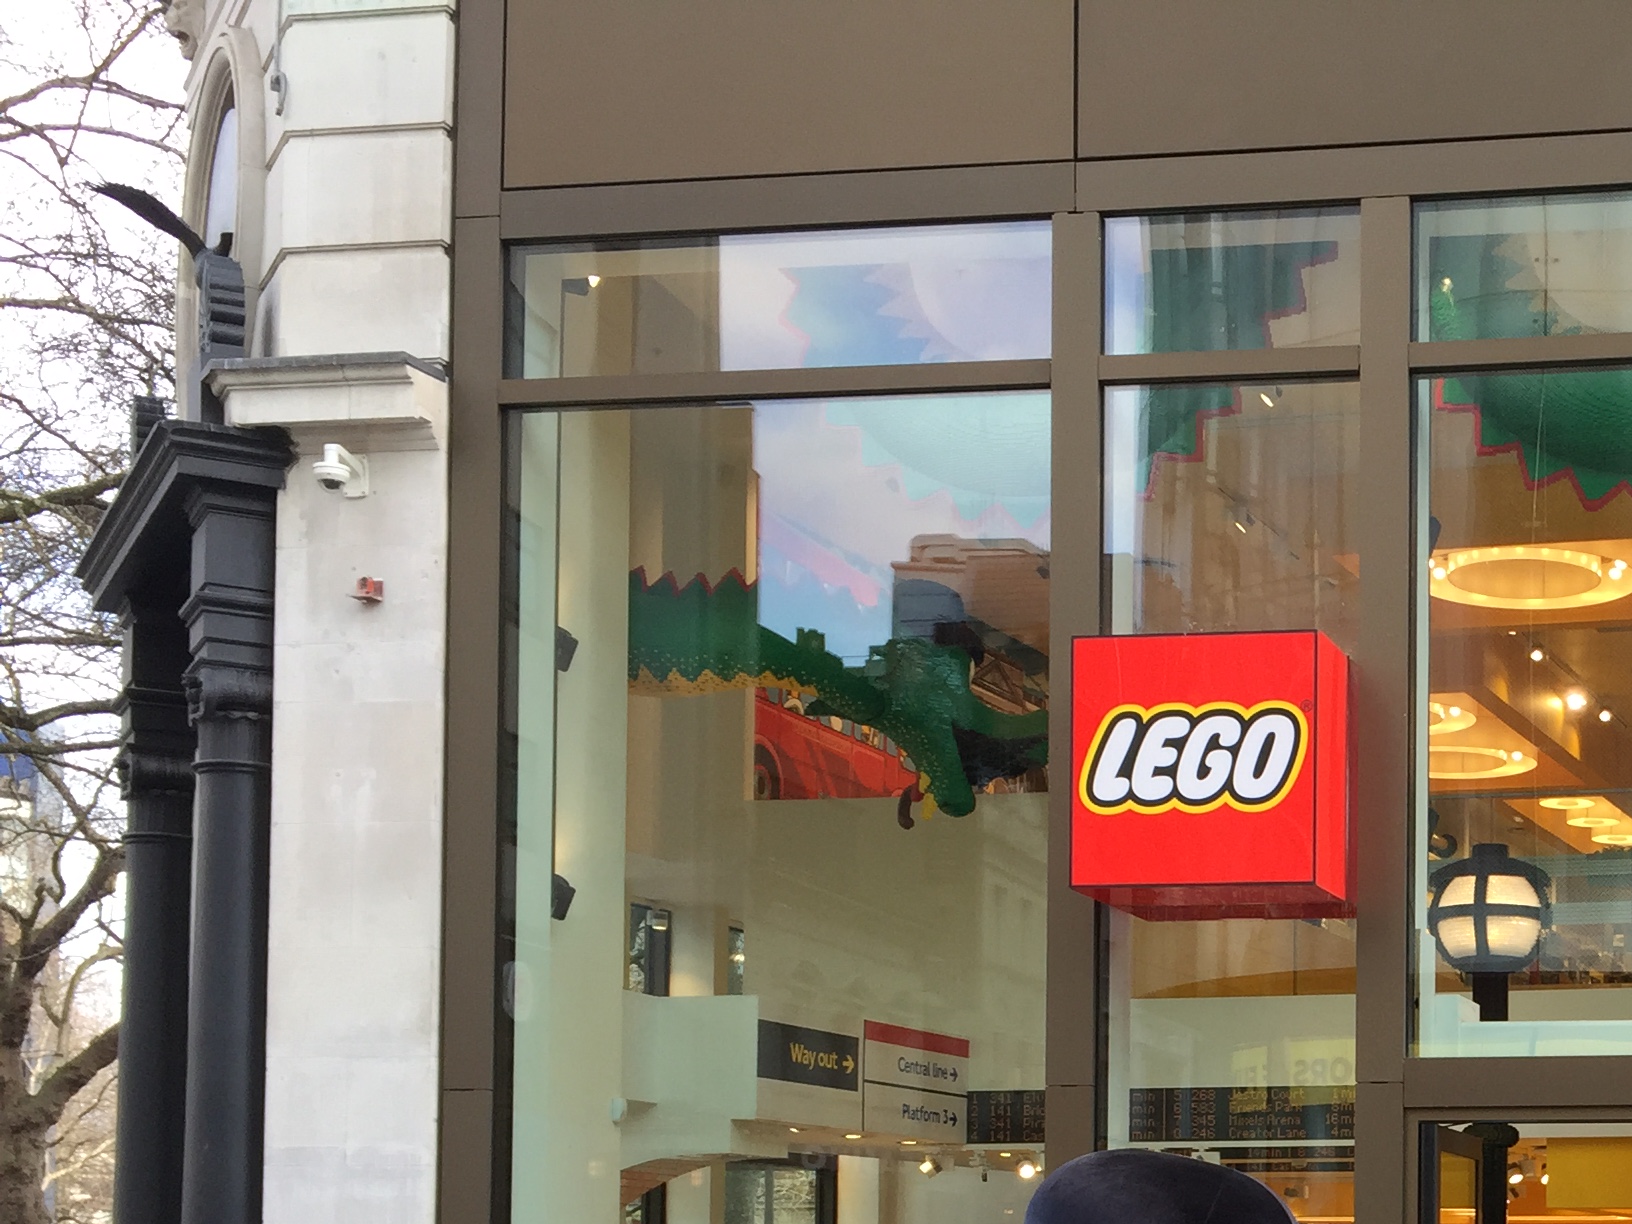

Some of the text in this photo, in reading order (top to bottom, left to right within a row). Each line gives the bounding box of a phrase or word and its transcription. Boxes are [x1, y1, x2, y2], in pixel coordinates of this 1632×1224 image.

[1084, 705, 1304, 808] LEGO
[790, 1042, 838, 1070] Way out
[897, 1056, 948, 1079] Central line
[902, 1103, 949, 1125] Platform 3
[1131, 1130, 1155, 1140] min
[1277, 1126, 1307, 1138] Lane
